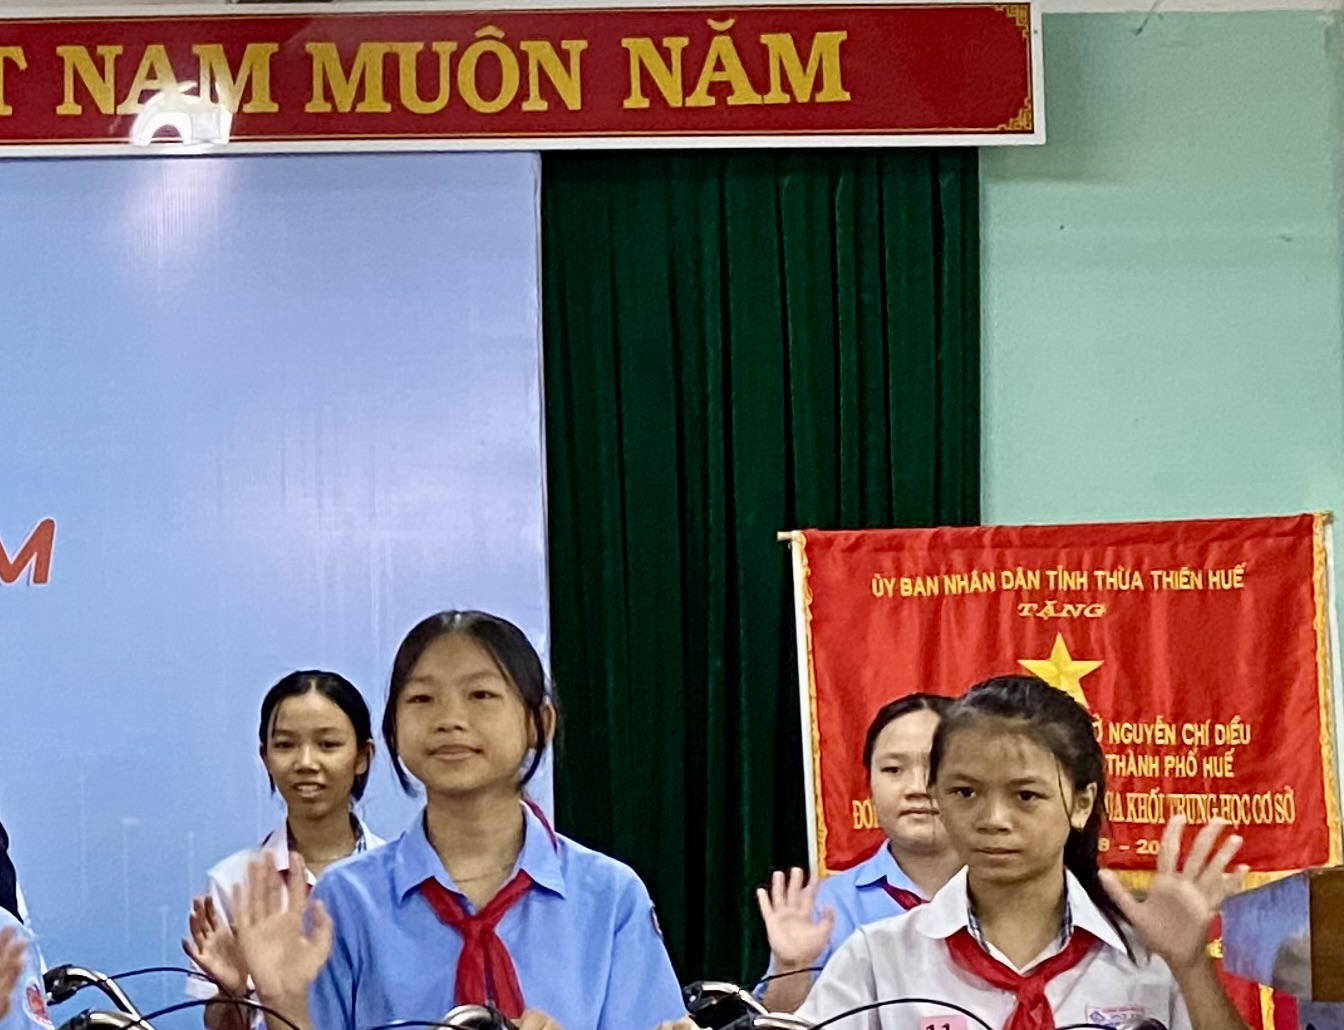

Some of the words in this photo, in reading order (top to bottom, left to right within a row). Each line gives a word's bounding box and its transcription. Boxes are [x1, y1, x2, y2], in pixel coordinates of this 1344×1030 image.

[56, 43, 279, 116] NAM
[305, 25, 588, 114] MUÔN
[621, 18, 852, 109] NĂM
[900, 576, 939, 597] BAN
[943, 569, 996, 595] NHÂN
[1001, 566, 1040, 590] DÂN
[1045, 565, 1089, 591] TỈNH
[1208, 562, 1247, 589] HUẾ
[1108, 715, 1176, 745] NGUYỄN
[1181, 719, 1209, 746] CHÍ
[1105, 749, 1160, 777] THÀNH
[1164, 747, 1198, 778] PHỐ
[1203, 748, 1236, 778] HUẾ
